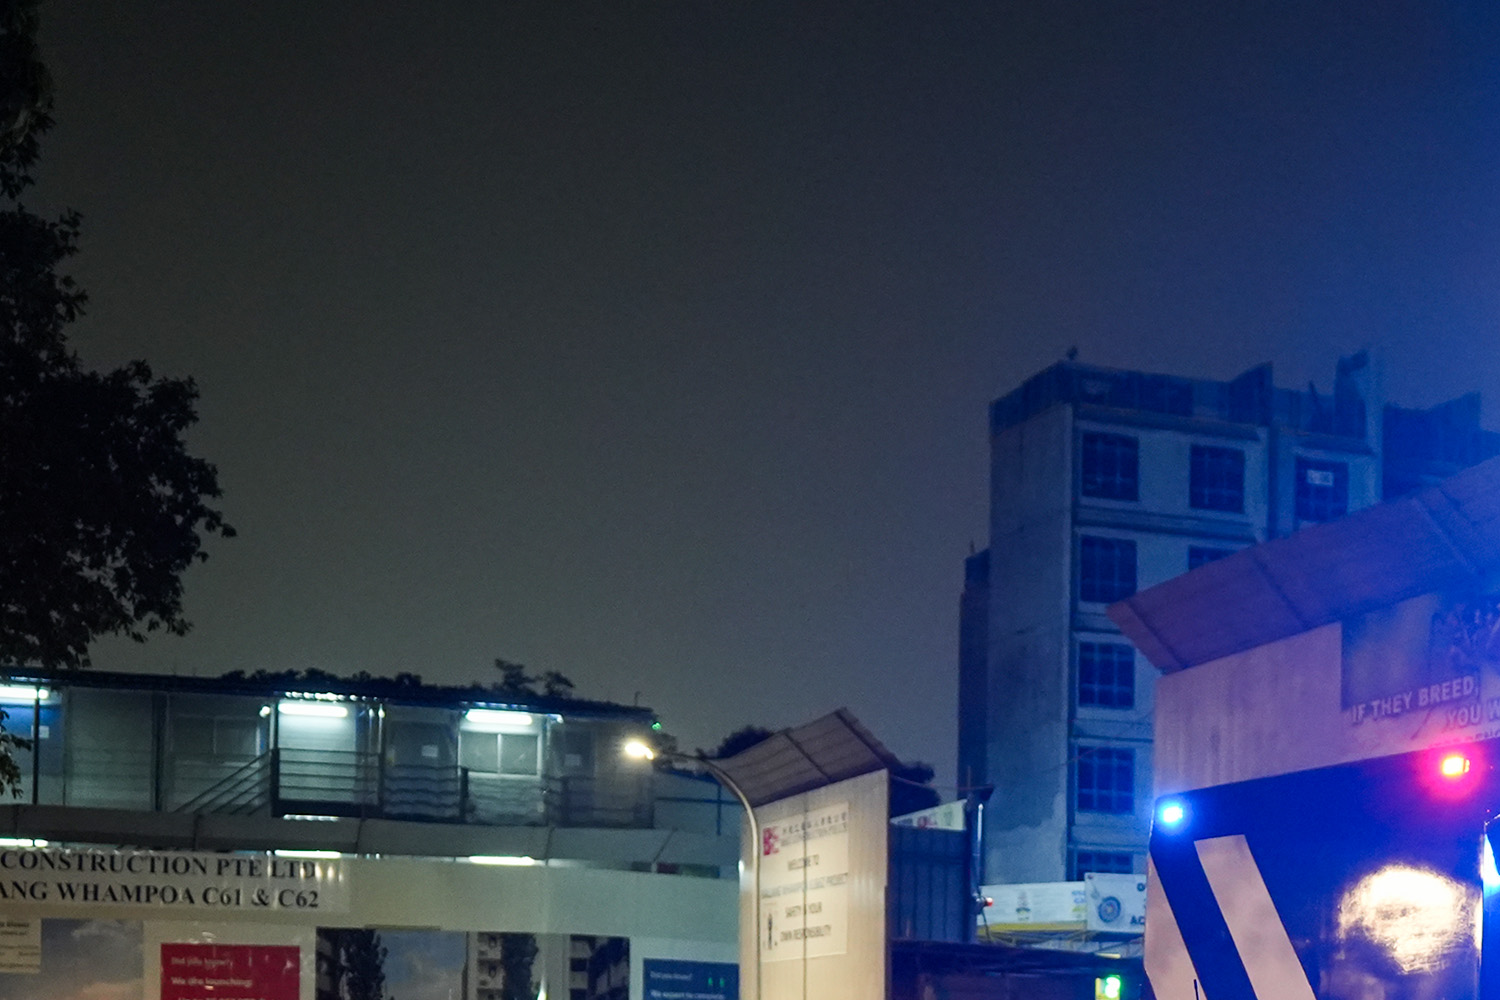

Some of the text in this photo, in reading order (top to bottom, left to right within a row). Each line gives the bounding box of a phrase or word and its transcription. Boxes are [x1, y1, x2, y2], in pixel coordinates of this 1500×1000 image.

[1352, 703, 1367, 723] IF
[1370, 691, 1413, 719] THEY
[1445, 703, 1482, 728] YOU
[0, 850, 317, 880] CONSTRUCTION PTE LTD
[0, 881, 320, 908] ANG WHAMPOA C61 & C62
